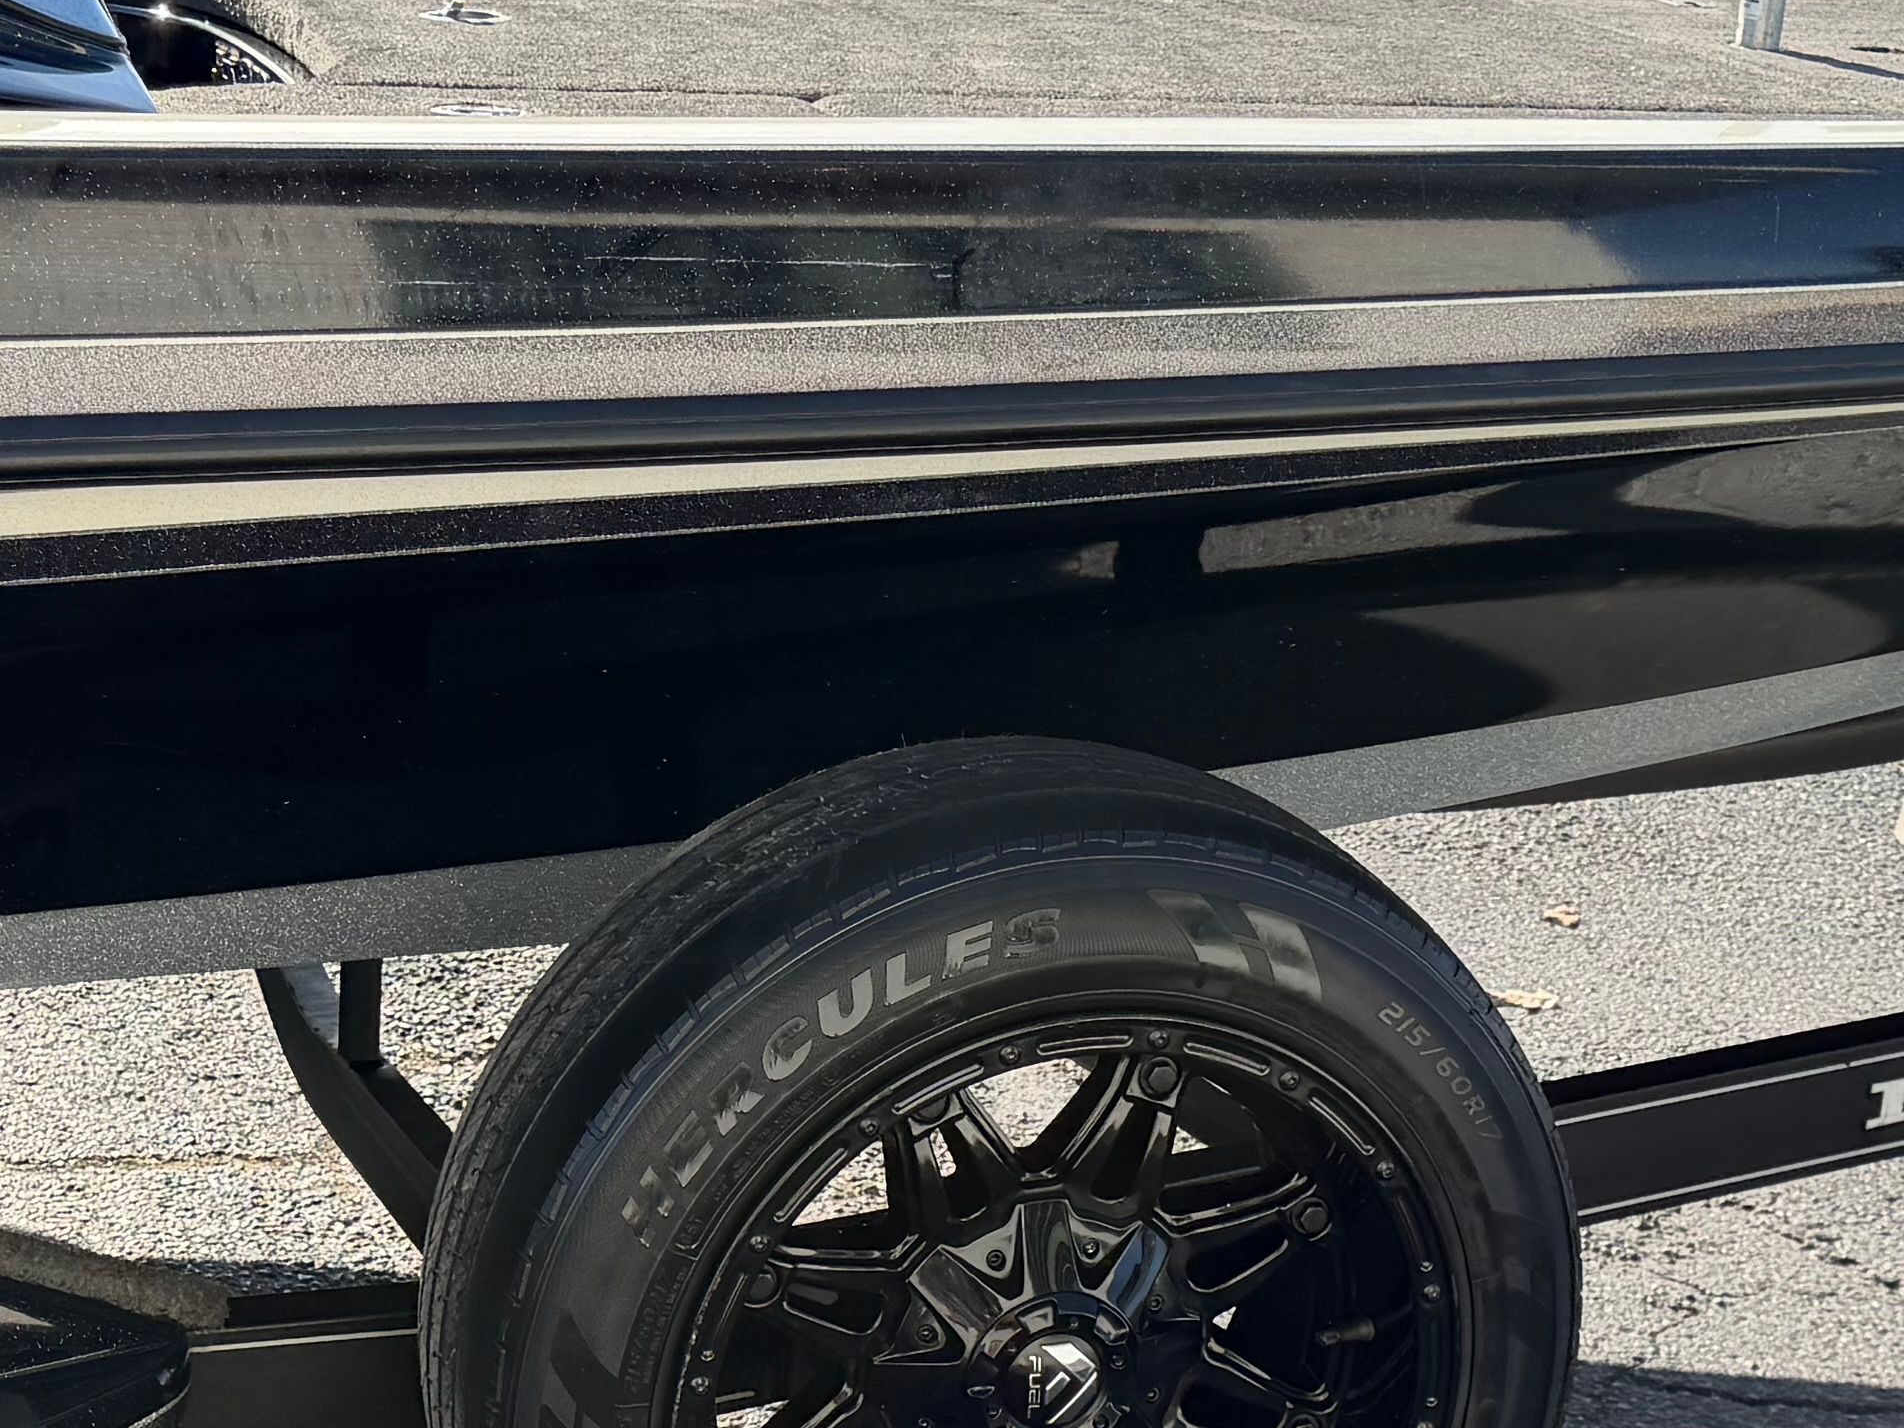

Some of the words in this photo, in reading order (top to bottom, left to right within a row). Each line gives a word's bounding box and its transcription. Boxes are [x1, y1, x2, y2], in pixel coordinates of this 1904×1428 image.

[620, 907, 1063, 1250] HERCULES
[1376, 1001, 1504, 1142] 215/60R17
[1026, 1354, 1043, 1420] FUEL
